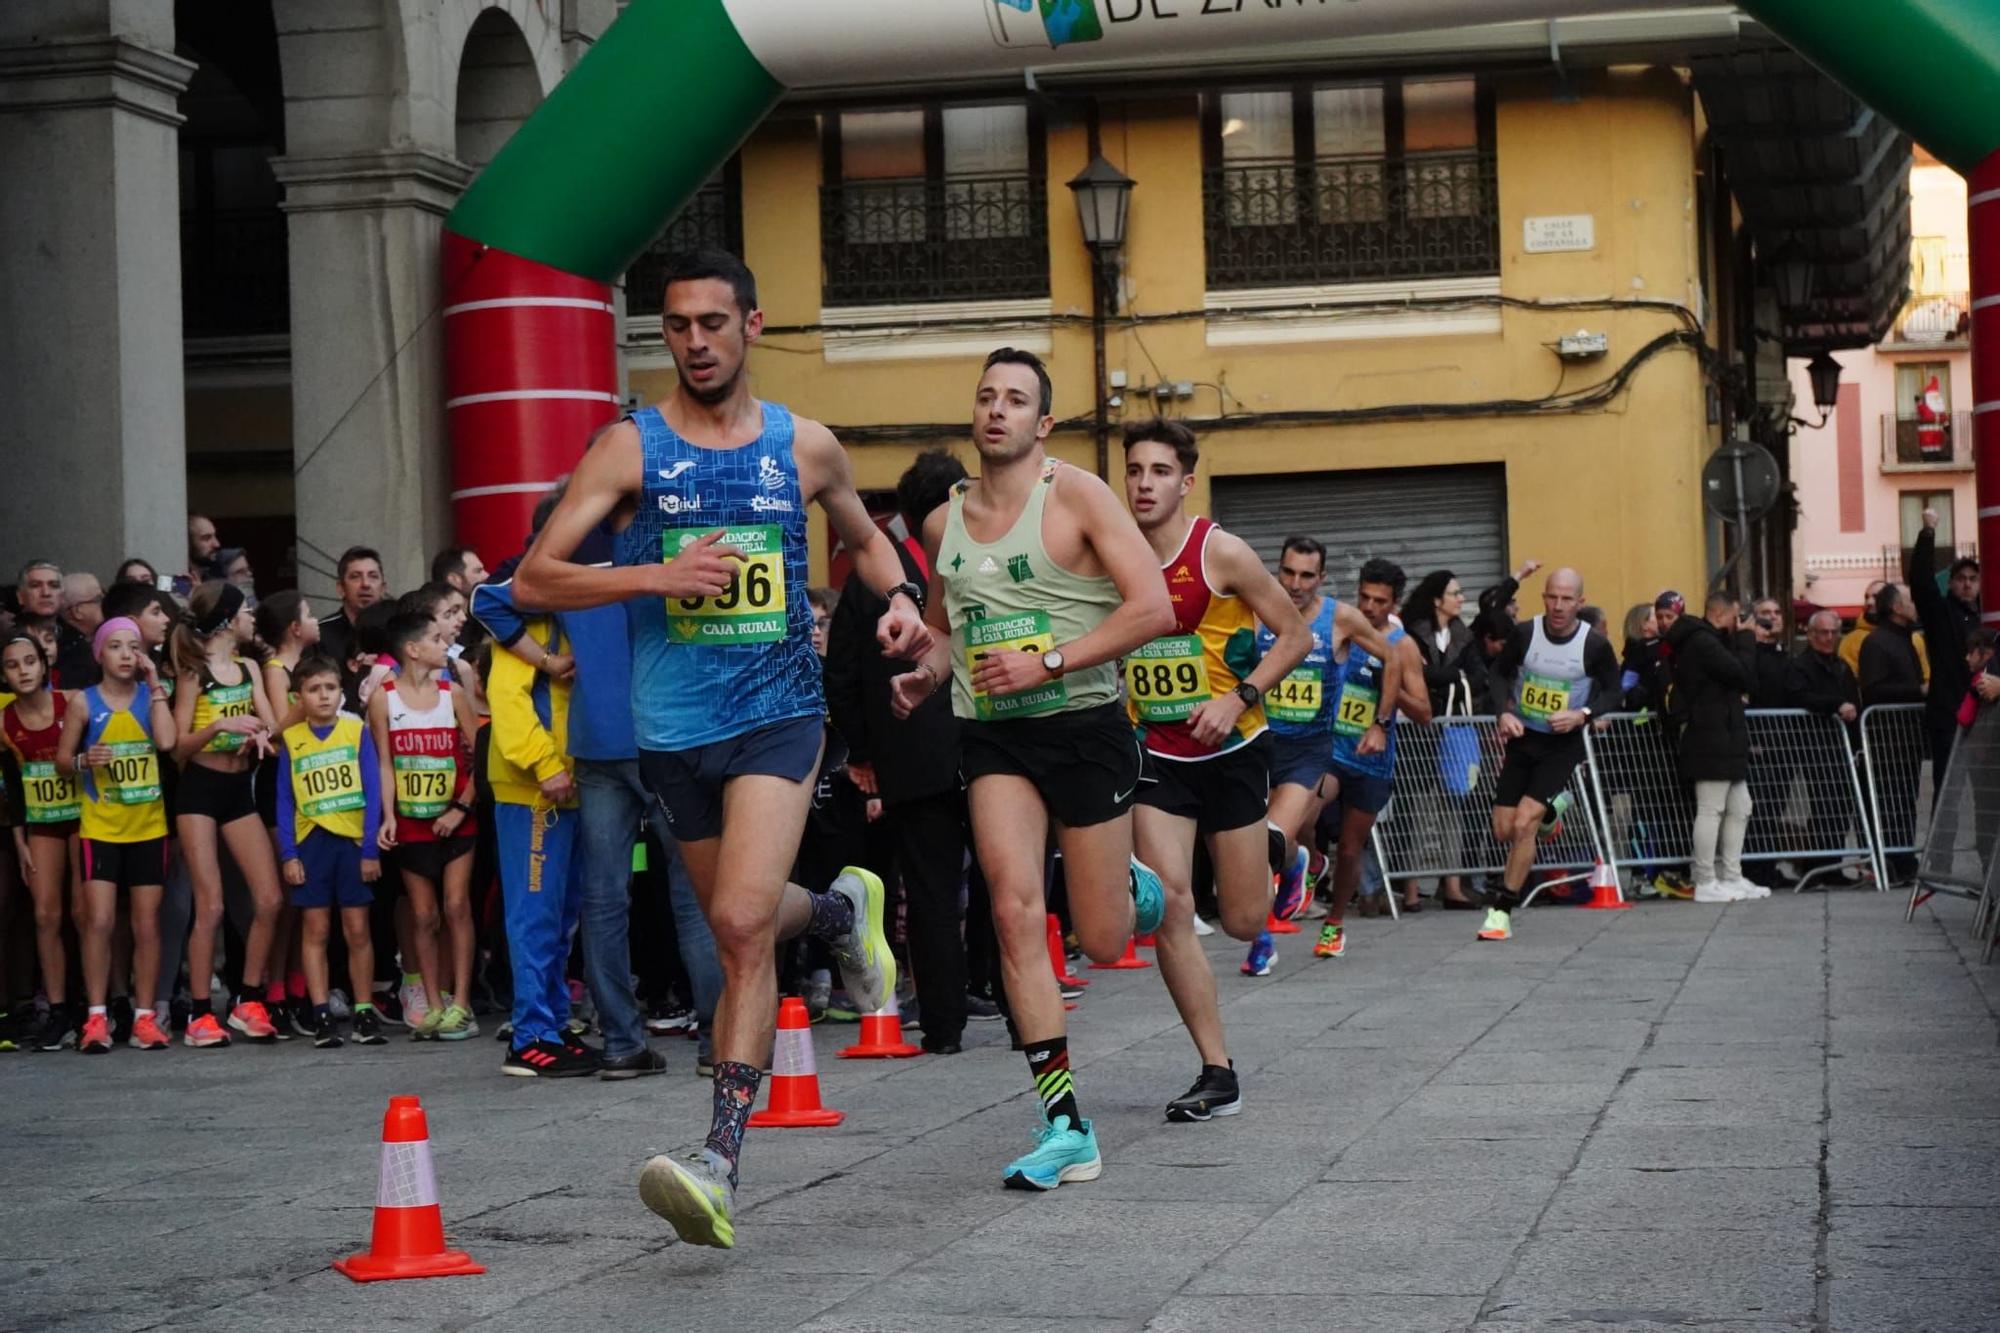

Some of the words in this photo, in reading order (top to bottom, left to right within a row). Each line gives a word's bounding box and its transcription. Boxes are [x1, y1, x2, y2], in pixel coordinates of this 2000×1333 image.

[680, 563, 771, 610] 96
[702, 623, 734, 635] CAJA
[738, 620, 780, 634] RURAL
[981, 616, 1036, 634] FUNDACION
[983, 632, 1003, 643] CAJA
[1004, 625, 1038, 640] RURAL
[1132, 663, 1198, 697] 889
[995, 698, 1019, 711] CAJA
[1021, 688, 1060, 706] RURAL
[1270, 683, 1314, 704] 444
[1525, 687, 1563, 711] 645
[1151, 705, 1173, 716] CAJA
[1343, 700, 1366, 723] 12
[395, 731, 453, 753] CURTIUS
[106, 757, 149, 784] 1007
[302, 764, 353, 796] 1098
[32, 777, 77, 803] 1031
[403, 773, 447, 797] 1073
